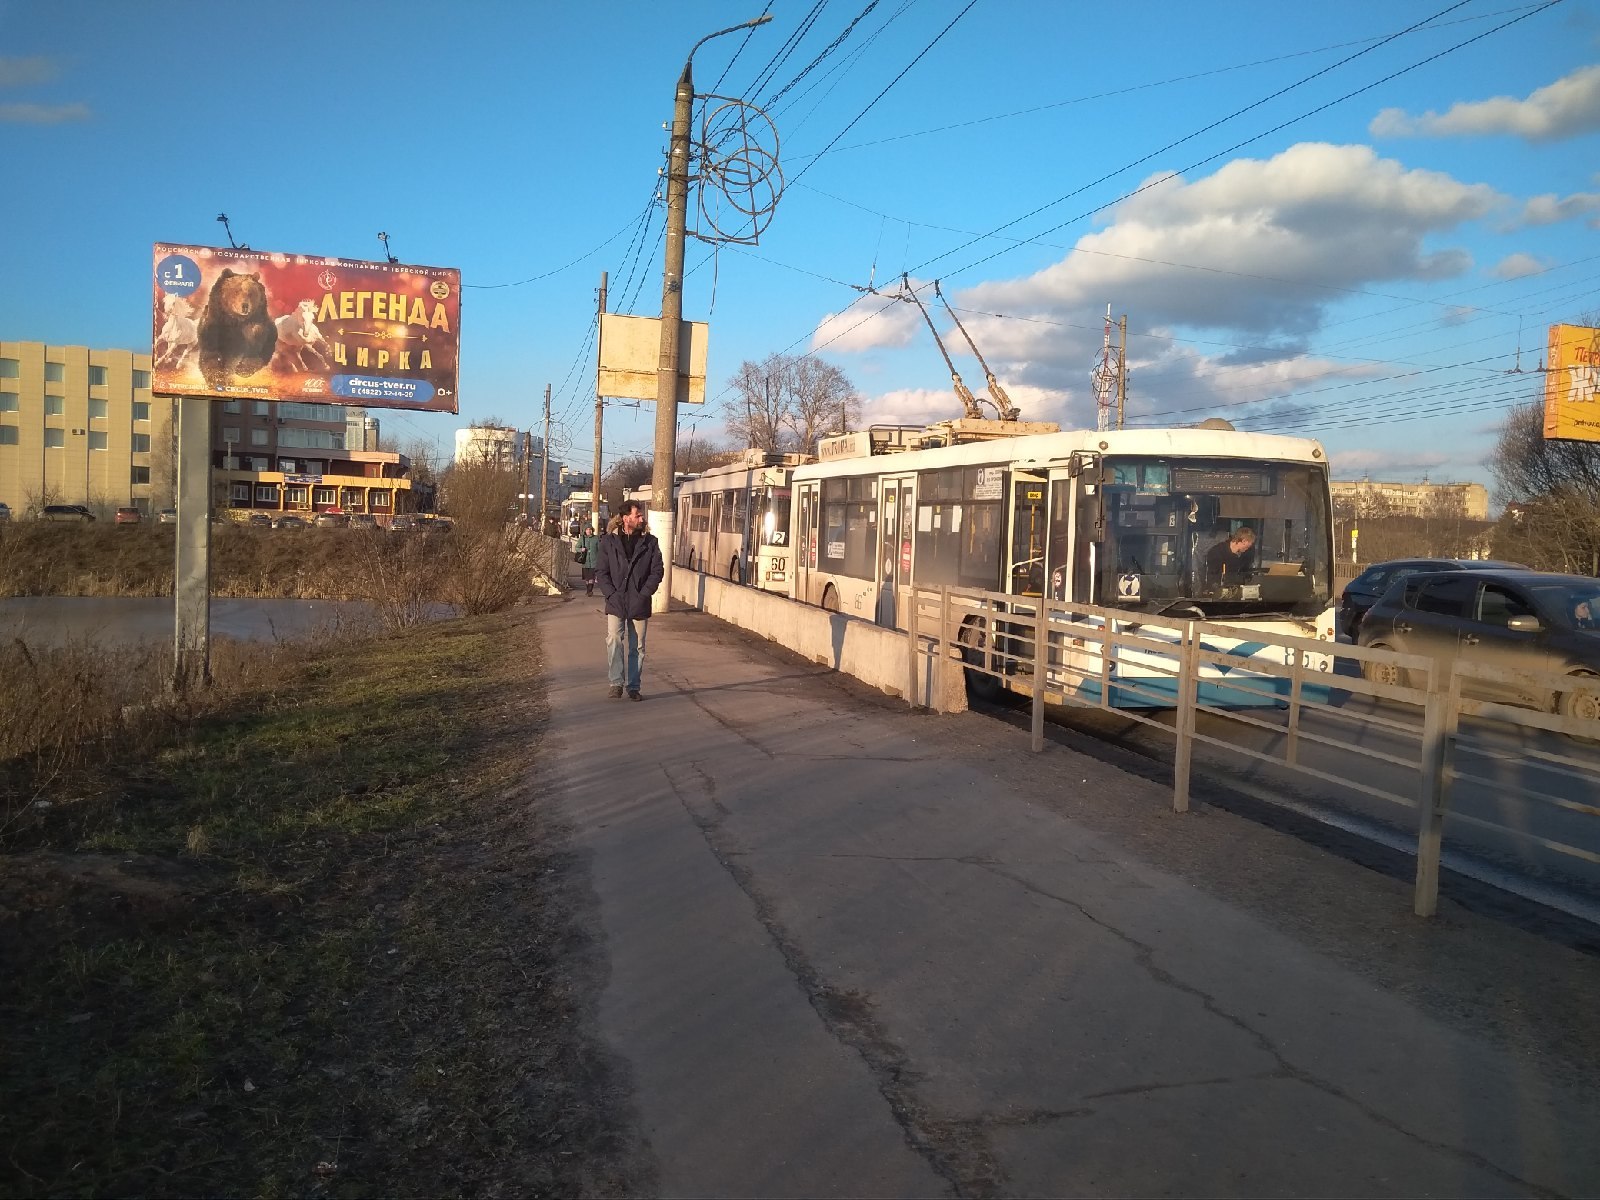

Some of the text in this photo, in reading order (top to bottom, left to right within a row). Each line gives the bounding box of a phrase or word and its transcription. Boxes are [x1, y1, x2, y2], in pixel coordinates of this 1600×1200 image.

[175, 263, 183, 279] 1
[317, 291, 450, 333] ЛЕГЕНДА
[334, 341, 432, 370] ЦИРКА
[348, 377, 416, 390] circus-tver.ru
[357, 388, 382, 396] (4822)
[437, 388, 452, 396] 0+
[773, 532, 783, 544] 2
[771, 557, 786, 571] 60
[1122, 574, 1136, 596] 7
